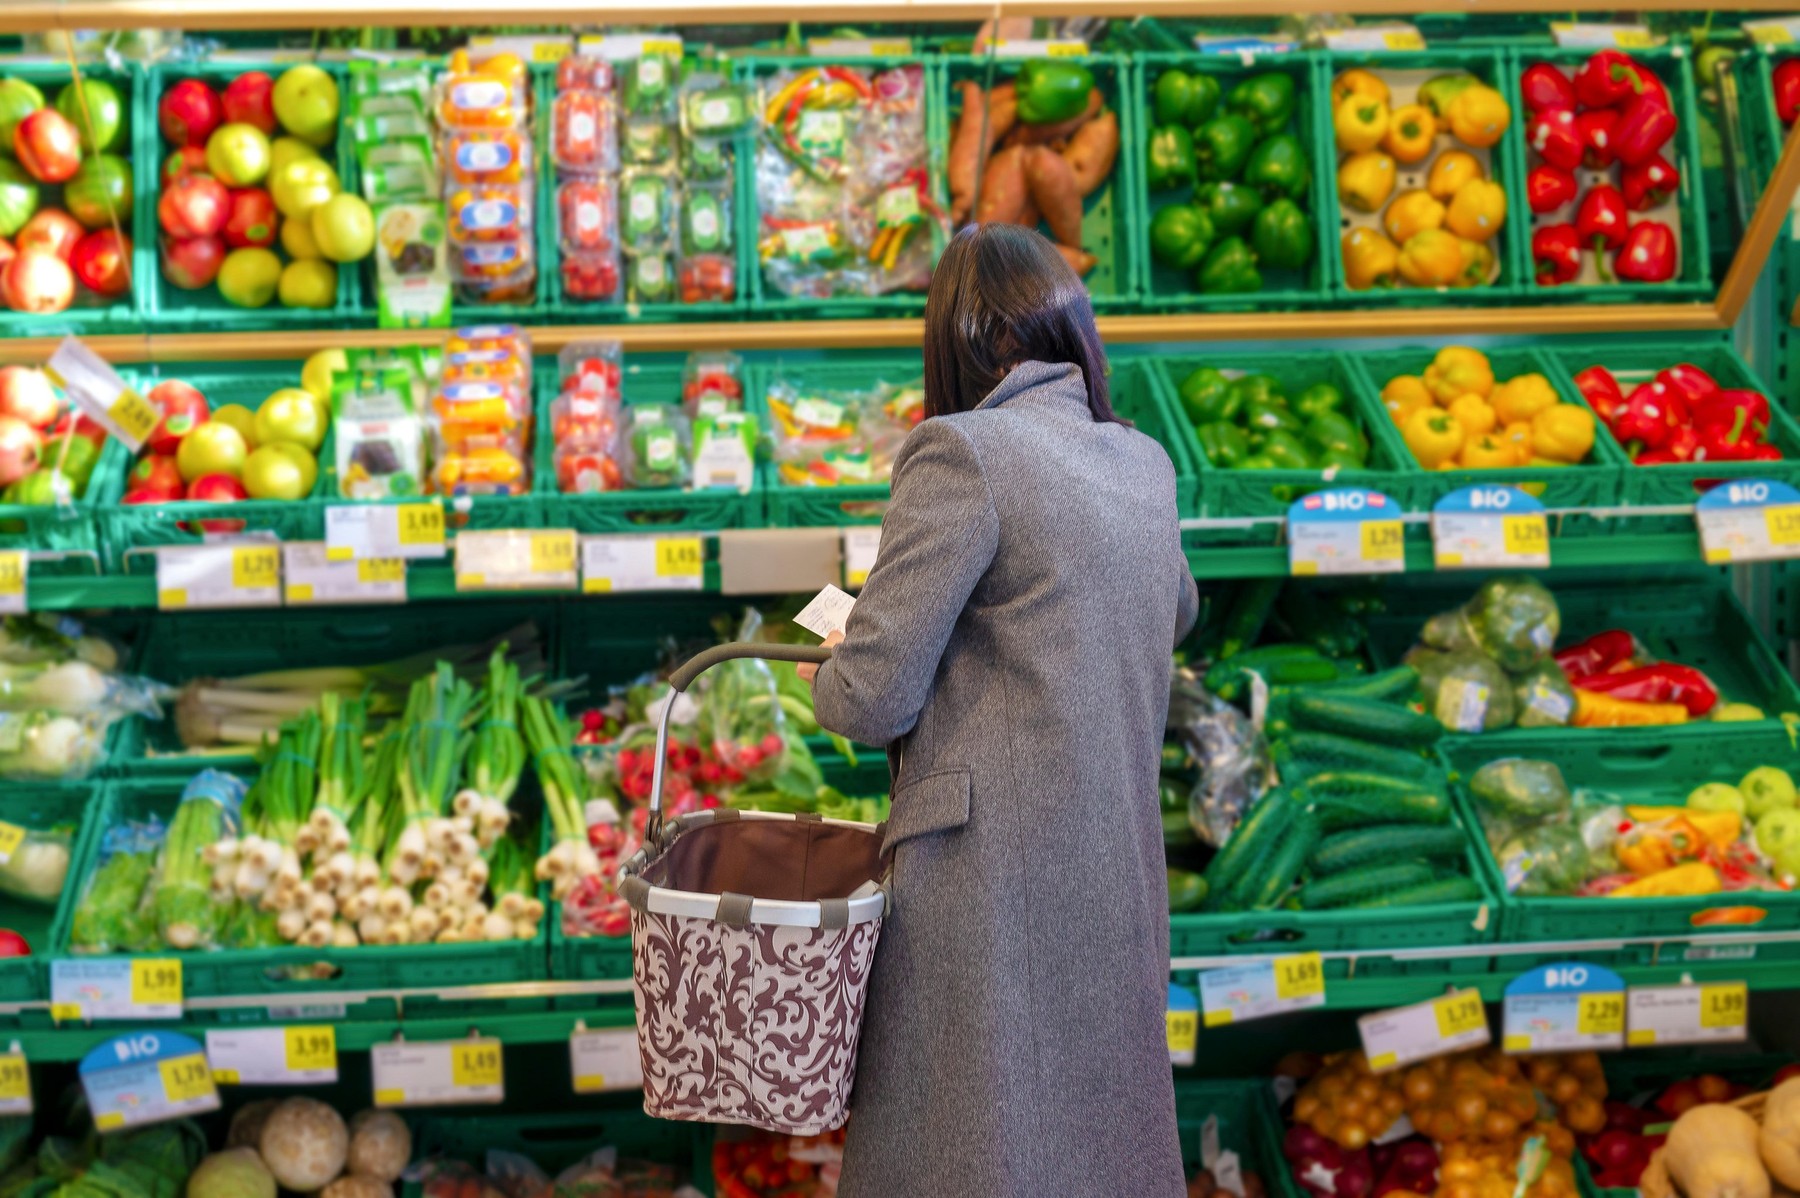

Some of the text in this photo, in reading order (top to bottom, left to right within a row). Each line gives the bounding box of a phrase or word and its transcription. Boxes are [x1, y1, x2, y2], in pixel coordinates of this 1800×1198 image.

[121, 398, 153, 430] 2,49
[1324, 491, 1365, 511] BIO
[1470, 488, 1511, 508] BIO
[1729, 481, 1769, 503] BIO
[407, 511, 439, 531] 3,49
[665, 546, 696, 565] 1,49
[143, 967, 177, 991] 1,99
[1285, 961, 1317, 985] 1,69
[1545, 967, 1588, 989] BIO
[1587, 1001, 1620, 1021] 2,29
[1711, 993, 1744, 1014] 1,99
[114, 1034, 160, 1061] BIO
[295, 1034, 331, 1057] 3,99
[462, 1050, 497, 1072] 1,49
